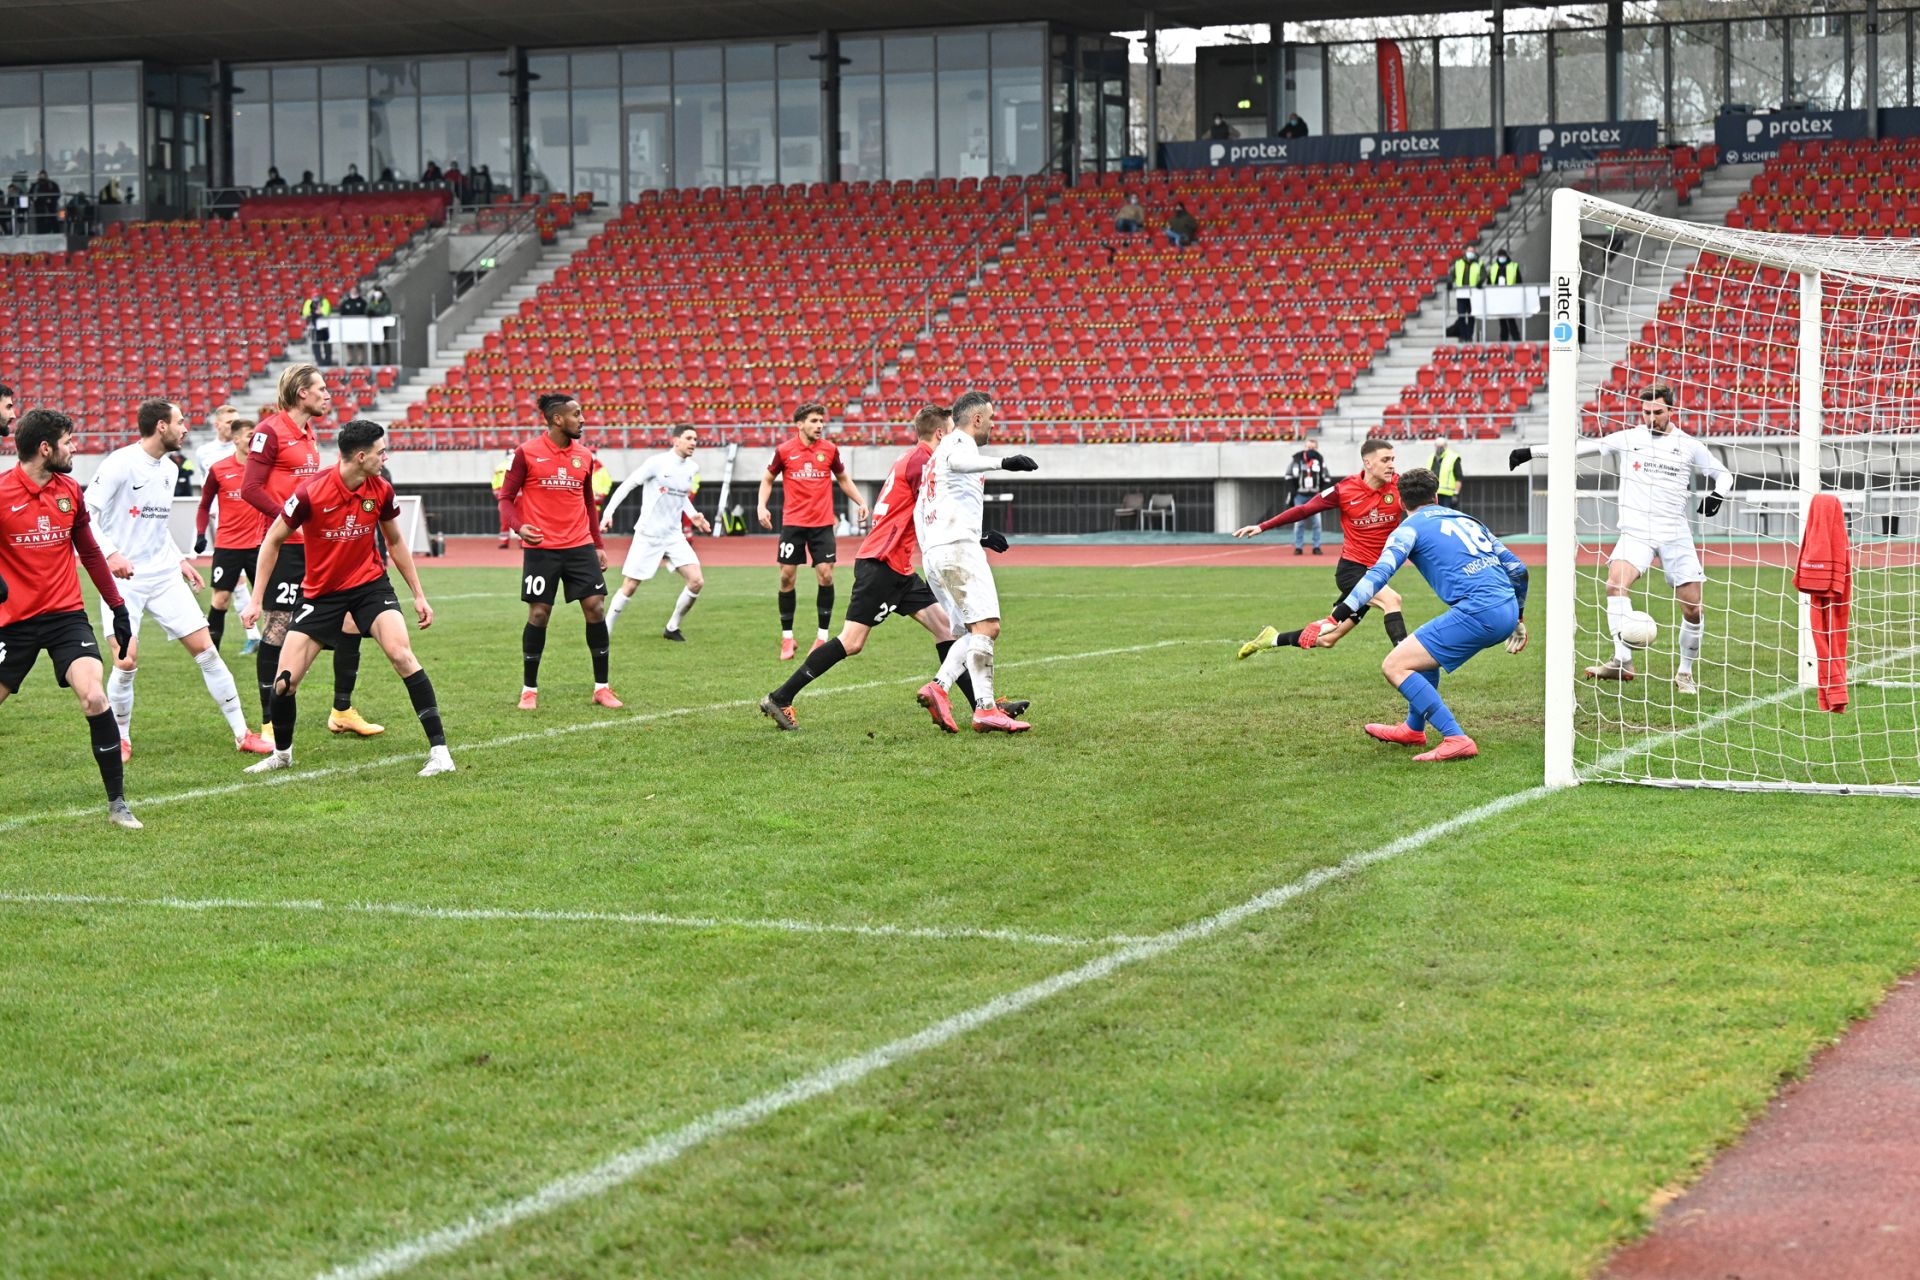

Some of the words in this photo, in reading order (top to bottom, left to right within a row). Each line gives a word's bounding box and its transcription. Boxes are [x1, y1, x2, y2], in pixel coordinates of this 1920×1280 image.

[1560, 127, 1621, 148] protex
[1771, 117, 1833, 138] protex
[1230, 143, 1288, 162] protex
[1381, 136, 1440, 155] protex
[1557, 276, 1573, 320] artec
[541, 479, 581, 487] SANWALD
[1353, 515, 1395, 525] SANWALD
[1440, 517, 1493, 556] 18
[779, 542, 795, 559] 19
[213, 566, 224, 583] 9
[276, 582, 299, 604] 25
[525, 575, 546, 596] 10
[294, 604, 315, 624] 7
